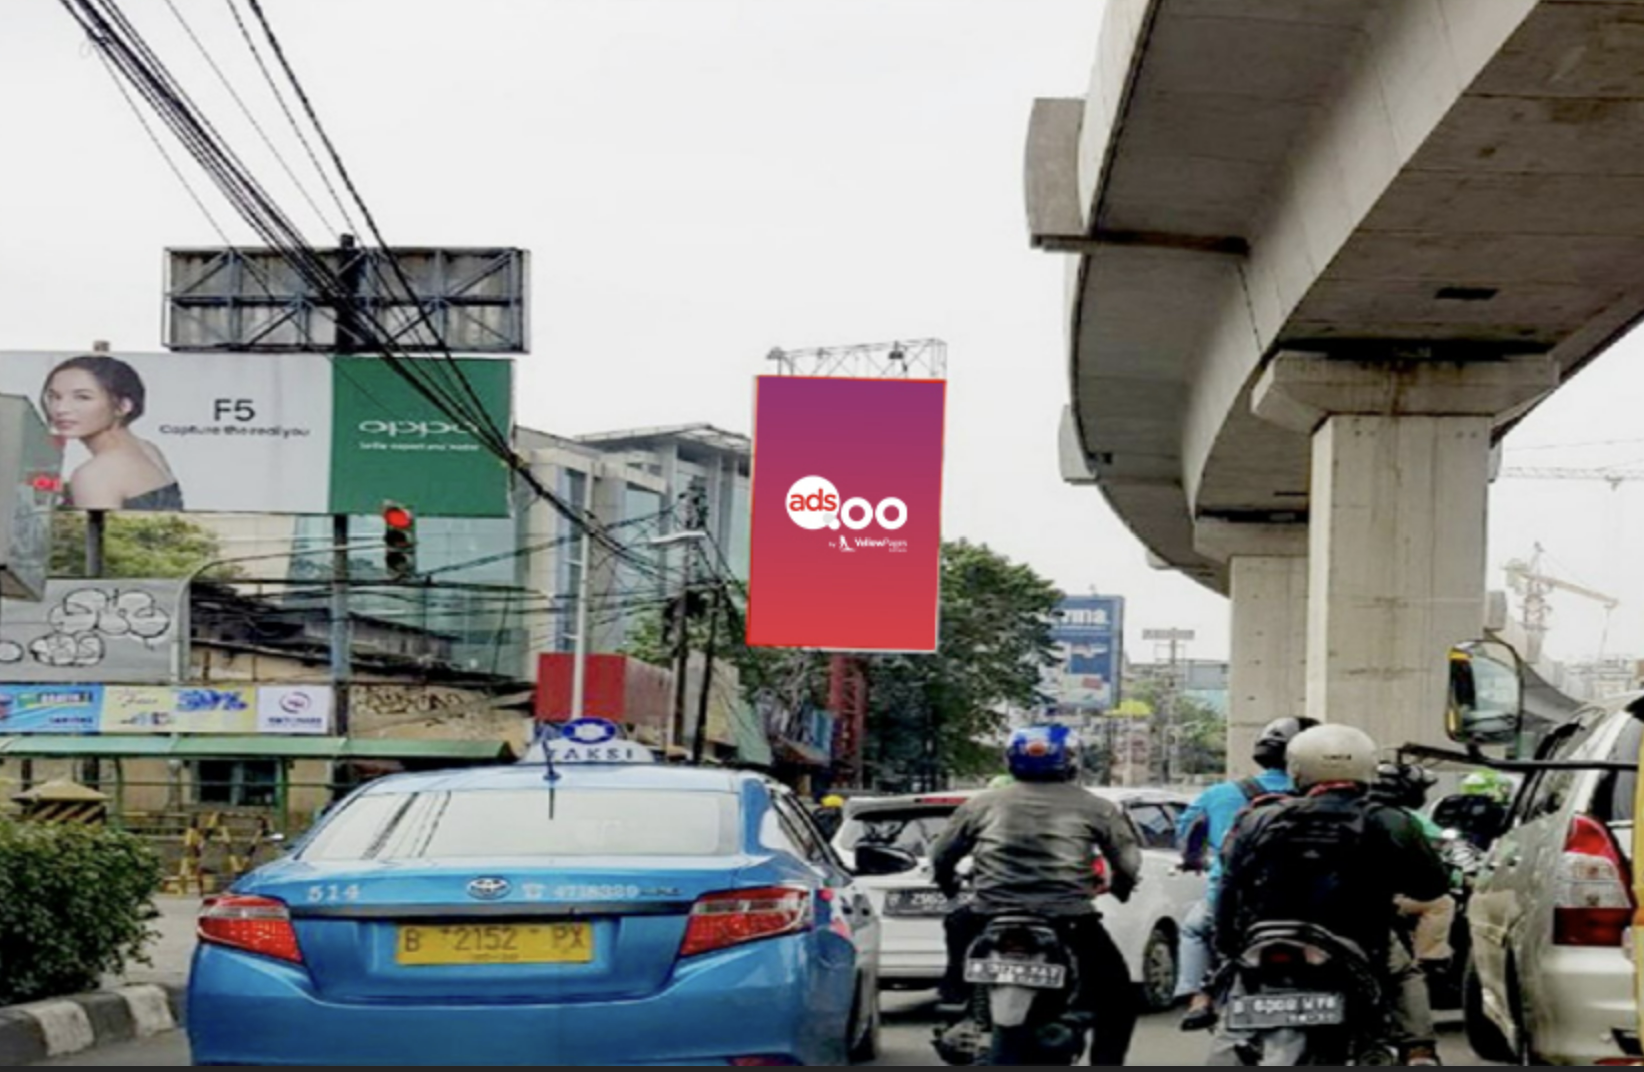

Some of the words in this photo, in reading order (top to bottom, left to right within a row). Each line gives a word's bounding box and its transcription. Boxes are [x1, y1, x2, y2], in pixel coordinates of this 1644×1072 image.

[213, 399, 256, 422] F5
[159, 425, 221, 437] Capture
[404, 927, 420, 953] B
[454, 925, 519, 952] 2152
[552, 924, 586, 950] PX
